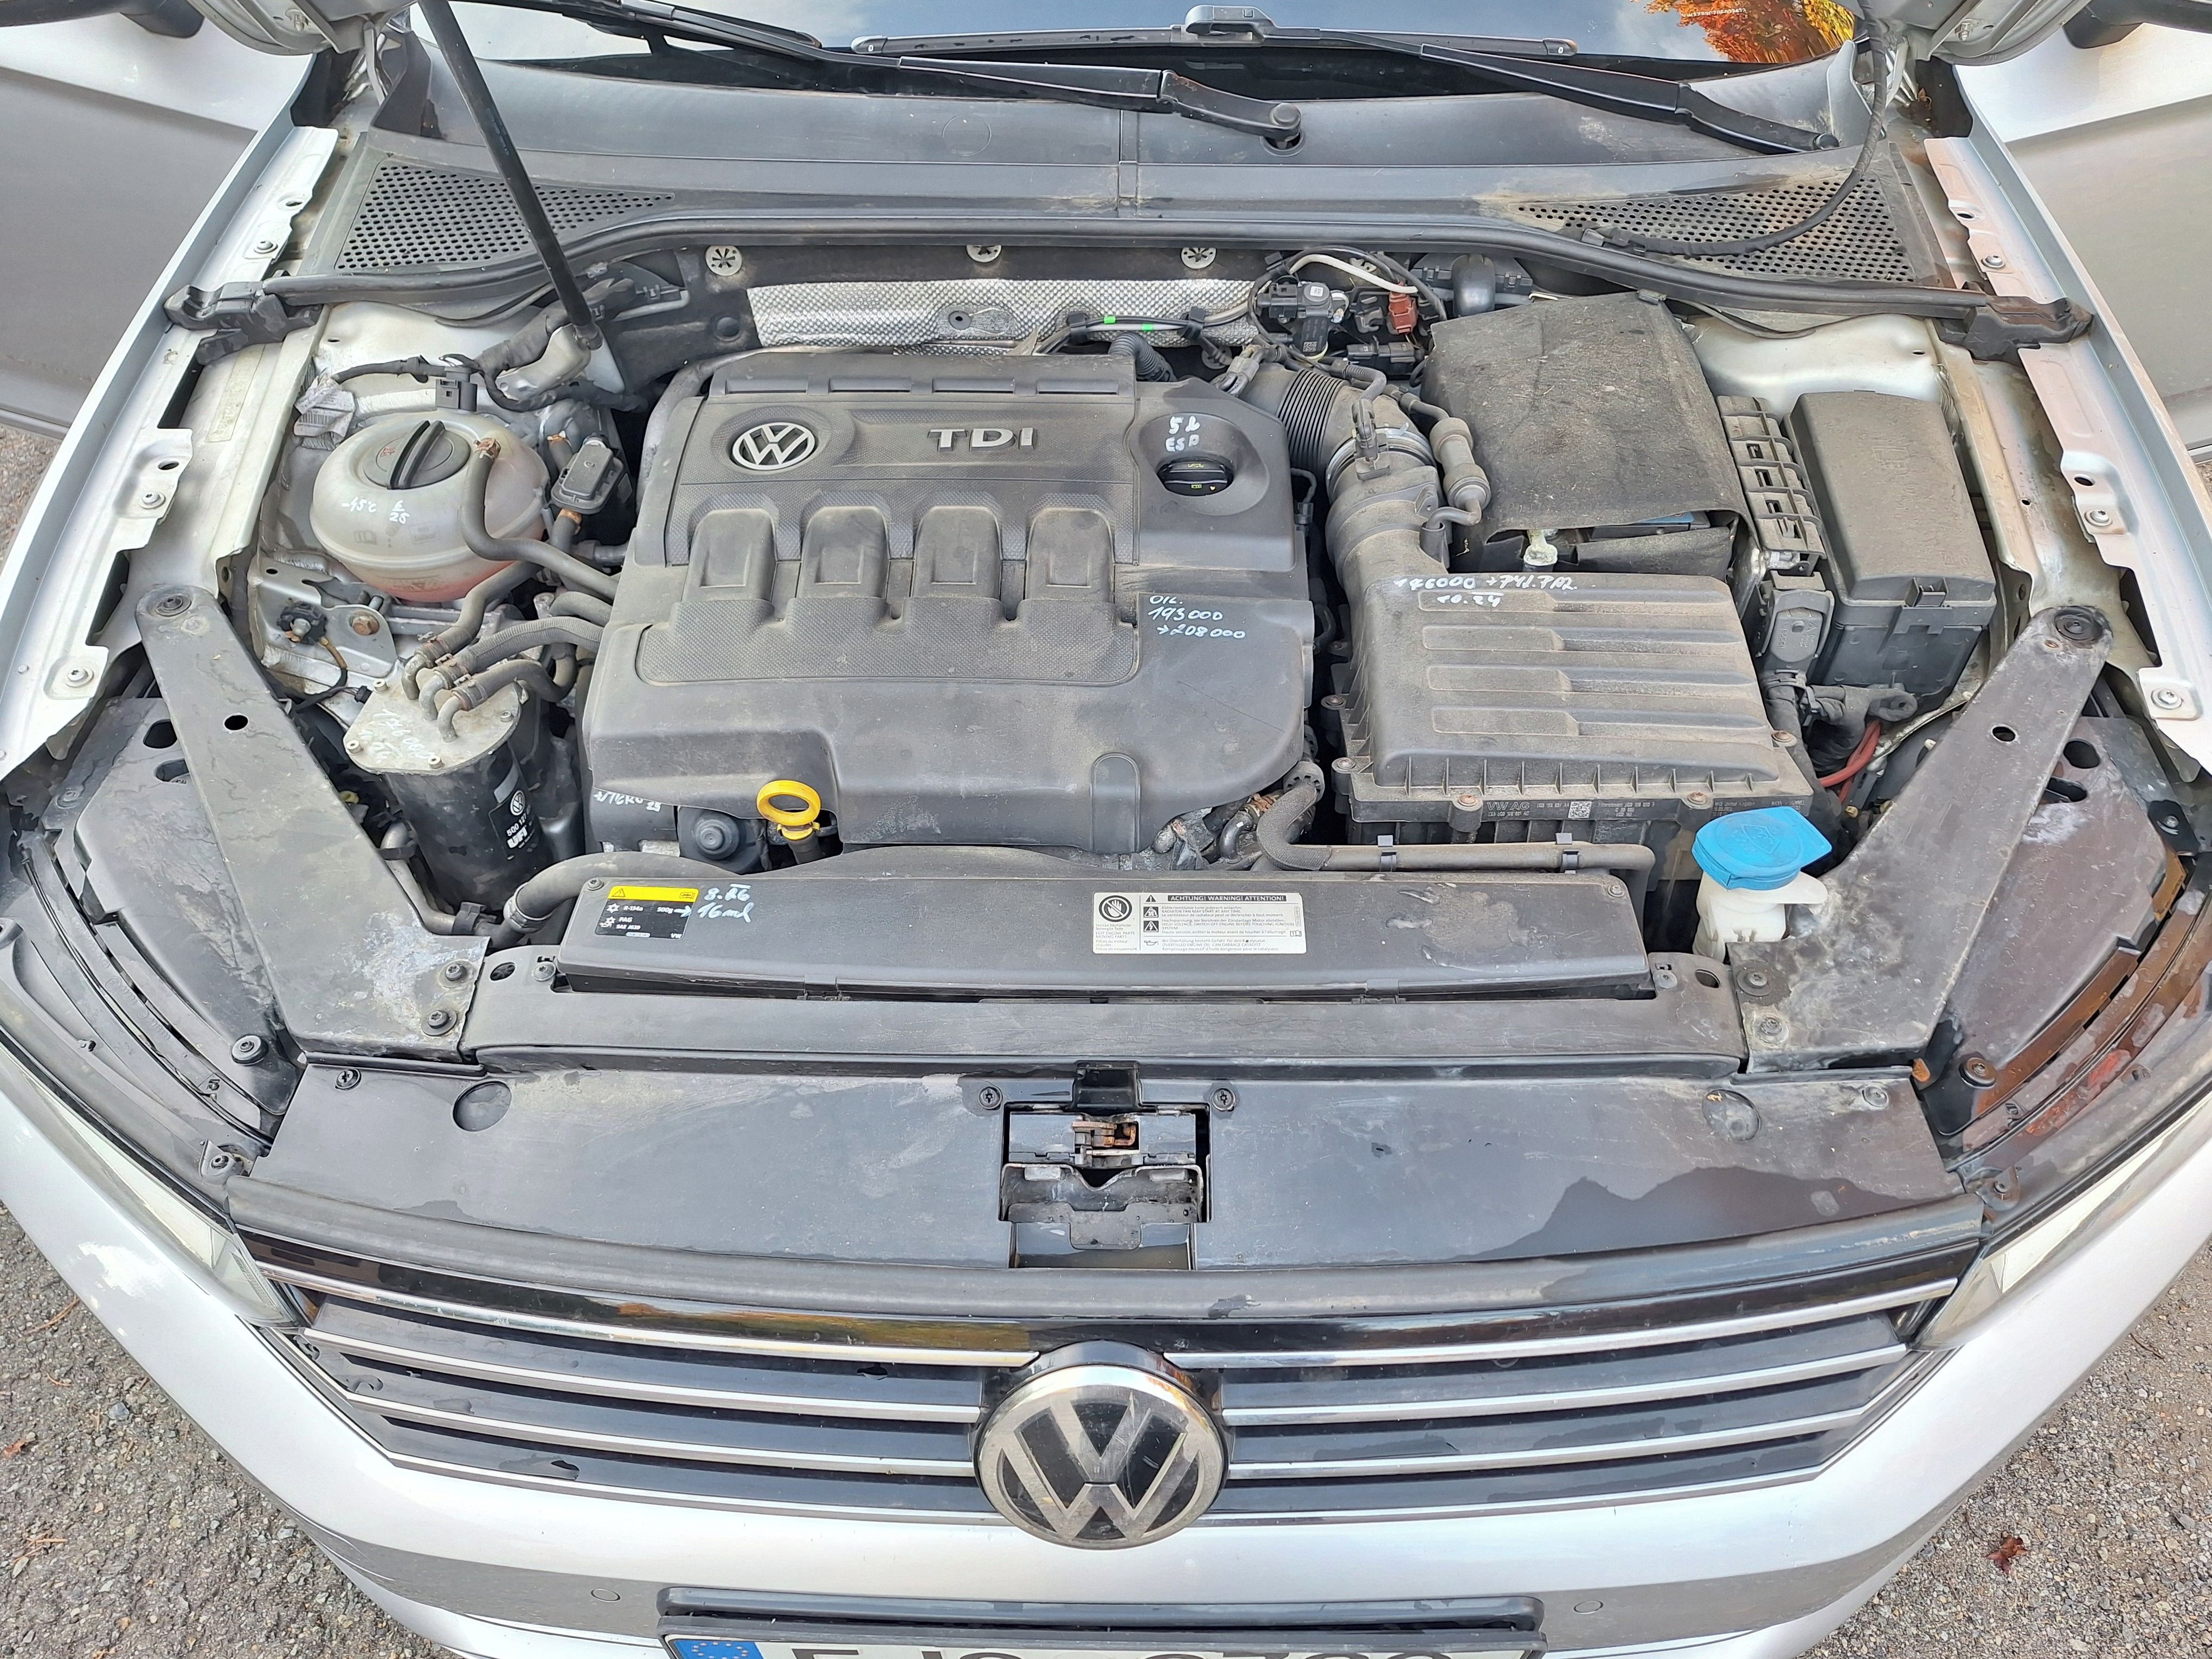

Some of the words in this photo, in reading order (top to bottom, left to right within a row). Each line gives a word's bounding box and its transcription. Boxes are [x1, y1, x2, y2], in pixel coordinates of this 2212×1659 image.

[1168, 416, 1184, 434] 5
[732, 422, 815, 470] VW
[928, 427, 1037, 452] TDI
[389, 512, 410, 524] 25
[1487, 802, 1508, 811] VW
[1510, 802, 1530, 811] AG
[507, 826, 528, 848] UFI
[979, 1365, 1223, 1550] VW
